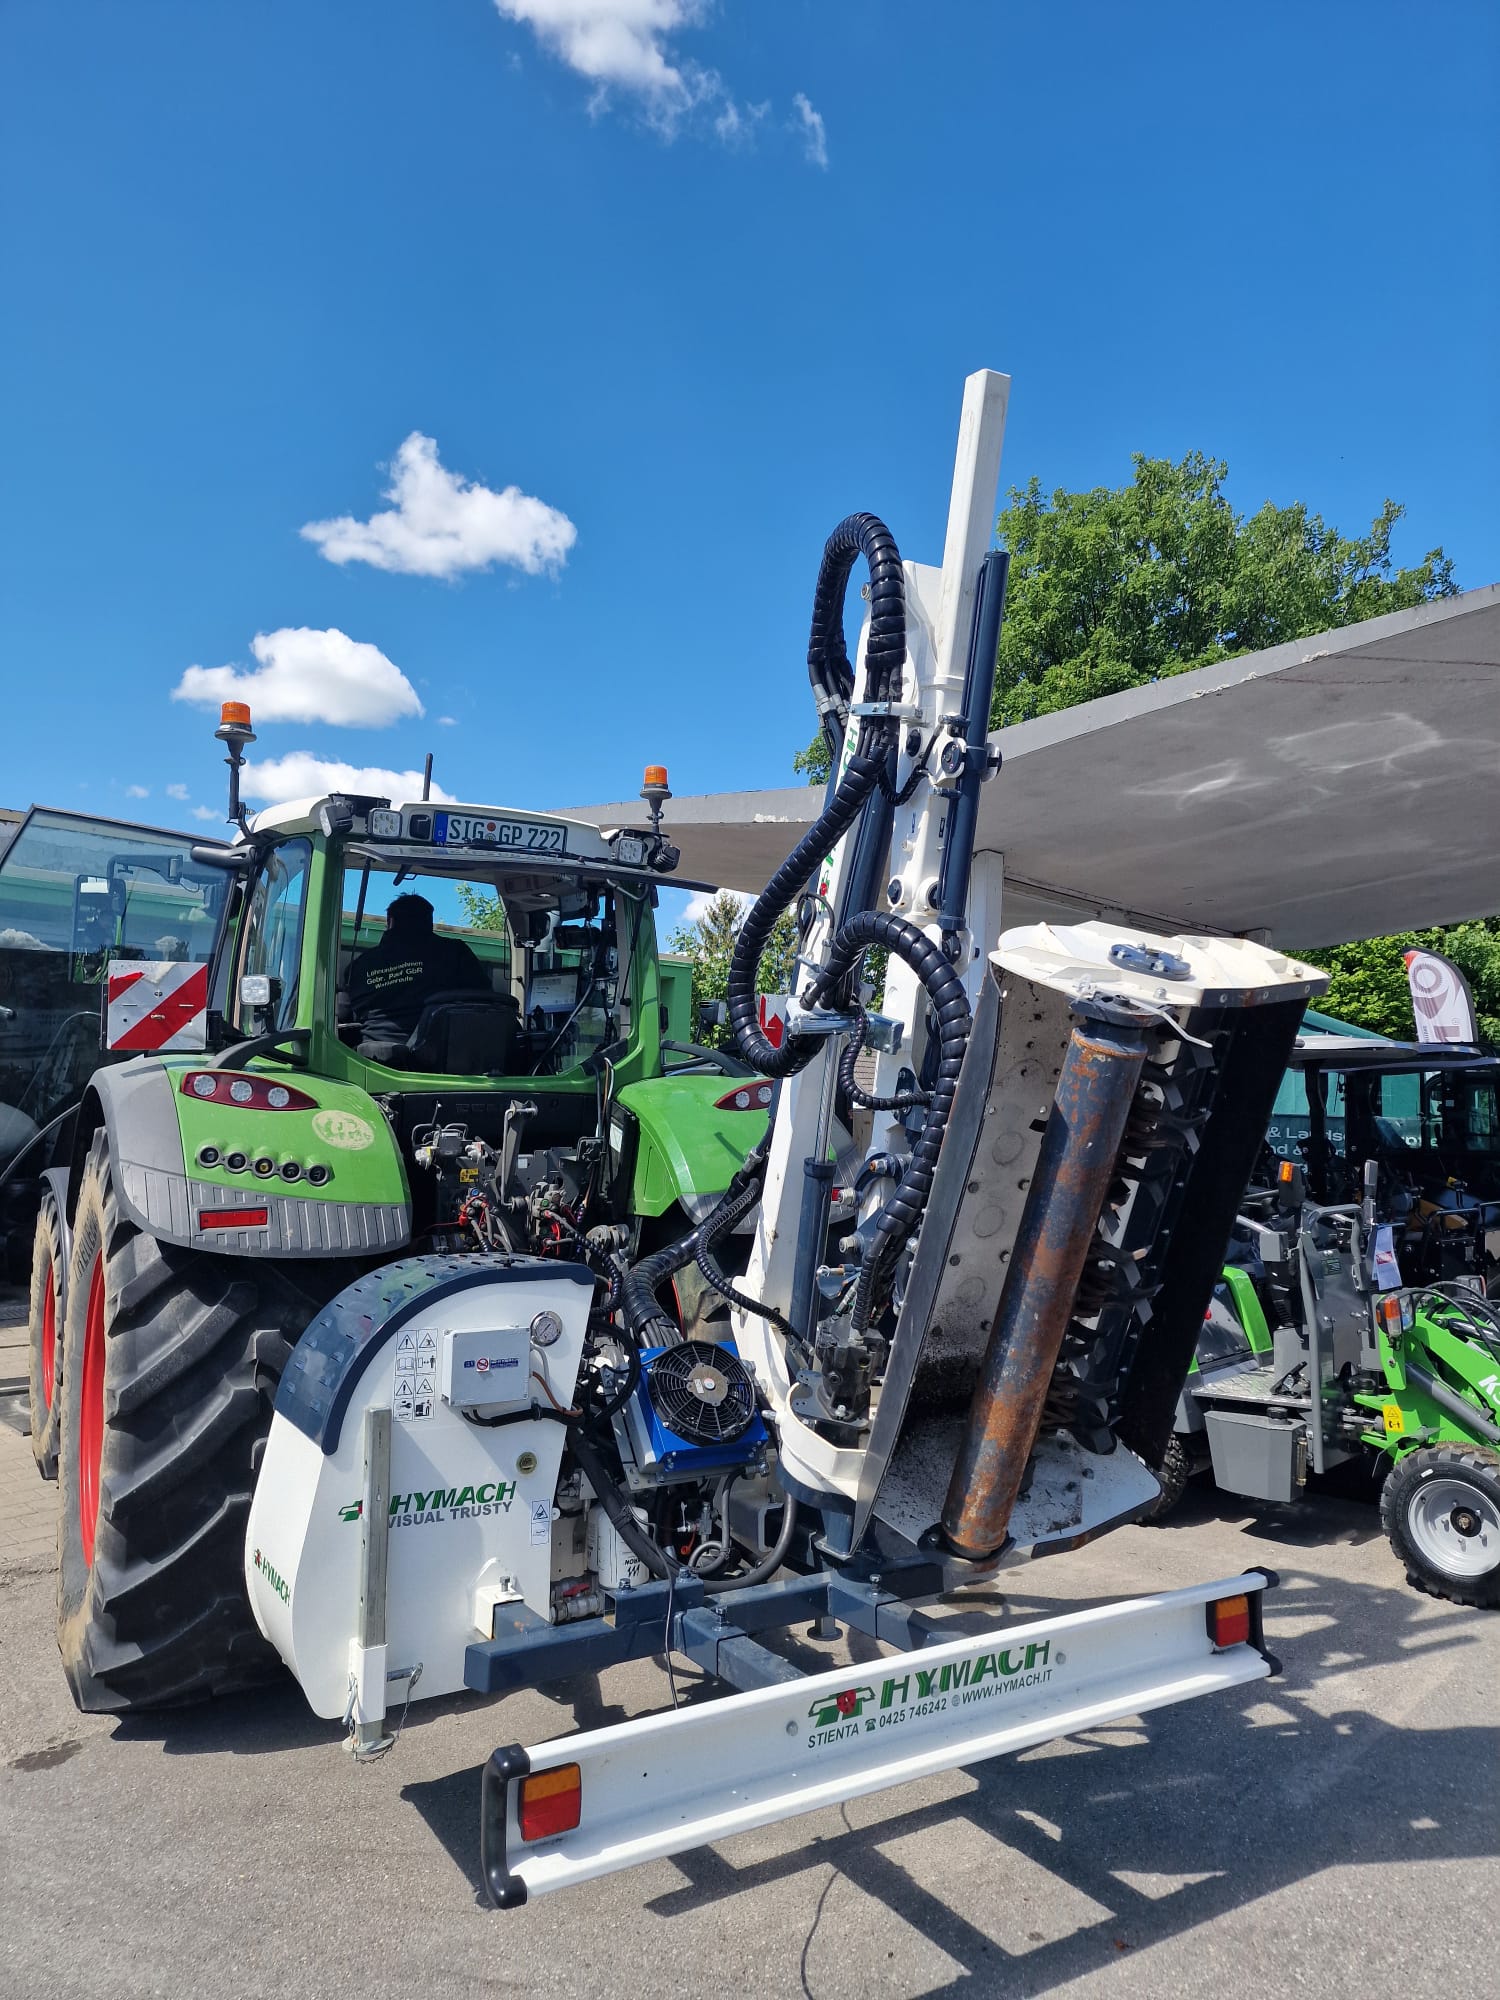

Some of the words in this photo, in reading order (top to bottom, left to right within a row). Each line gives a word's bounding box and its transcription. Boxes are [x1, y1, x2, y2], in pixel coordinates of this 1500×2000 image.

[449, 819, 484, 840] SIG
[500, 824, 523, 845] GP
[527, 827, 561, 849] 722
[389, 1480, 517, 1515] HYMACH
[450, 1500, 513, 1521] TRUSTY
[262, 1556, 291, 1608] HYMACH
[880, 1639, 1051, 1710] HYMACH
[807, 1722, 859, 1749] STIENTA
[879, 1710, 906, 1728] 0425
[908, 1697, 947, 1720] 746242
